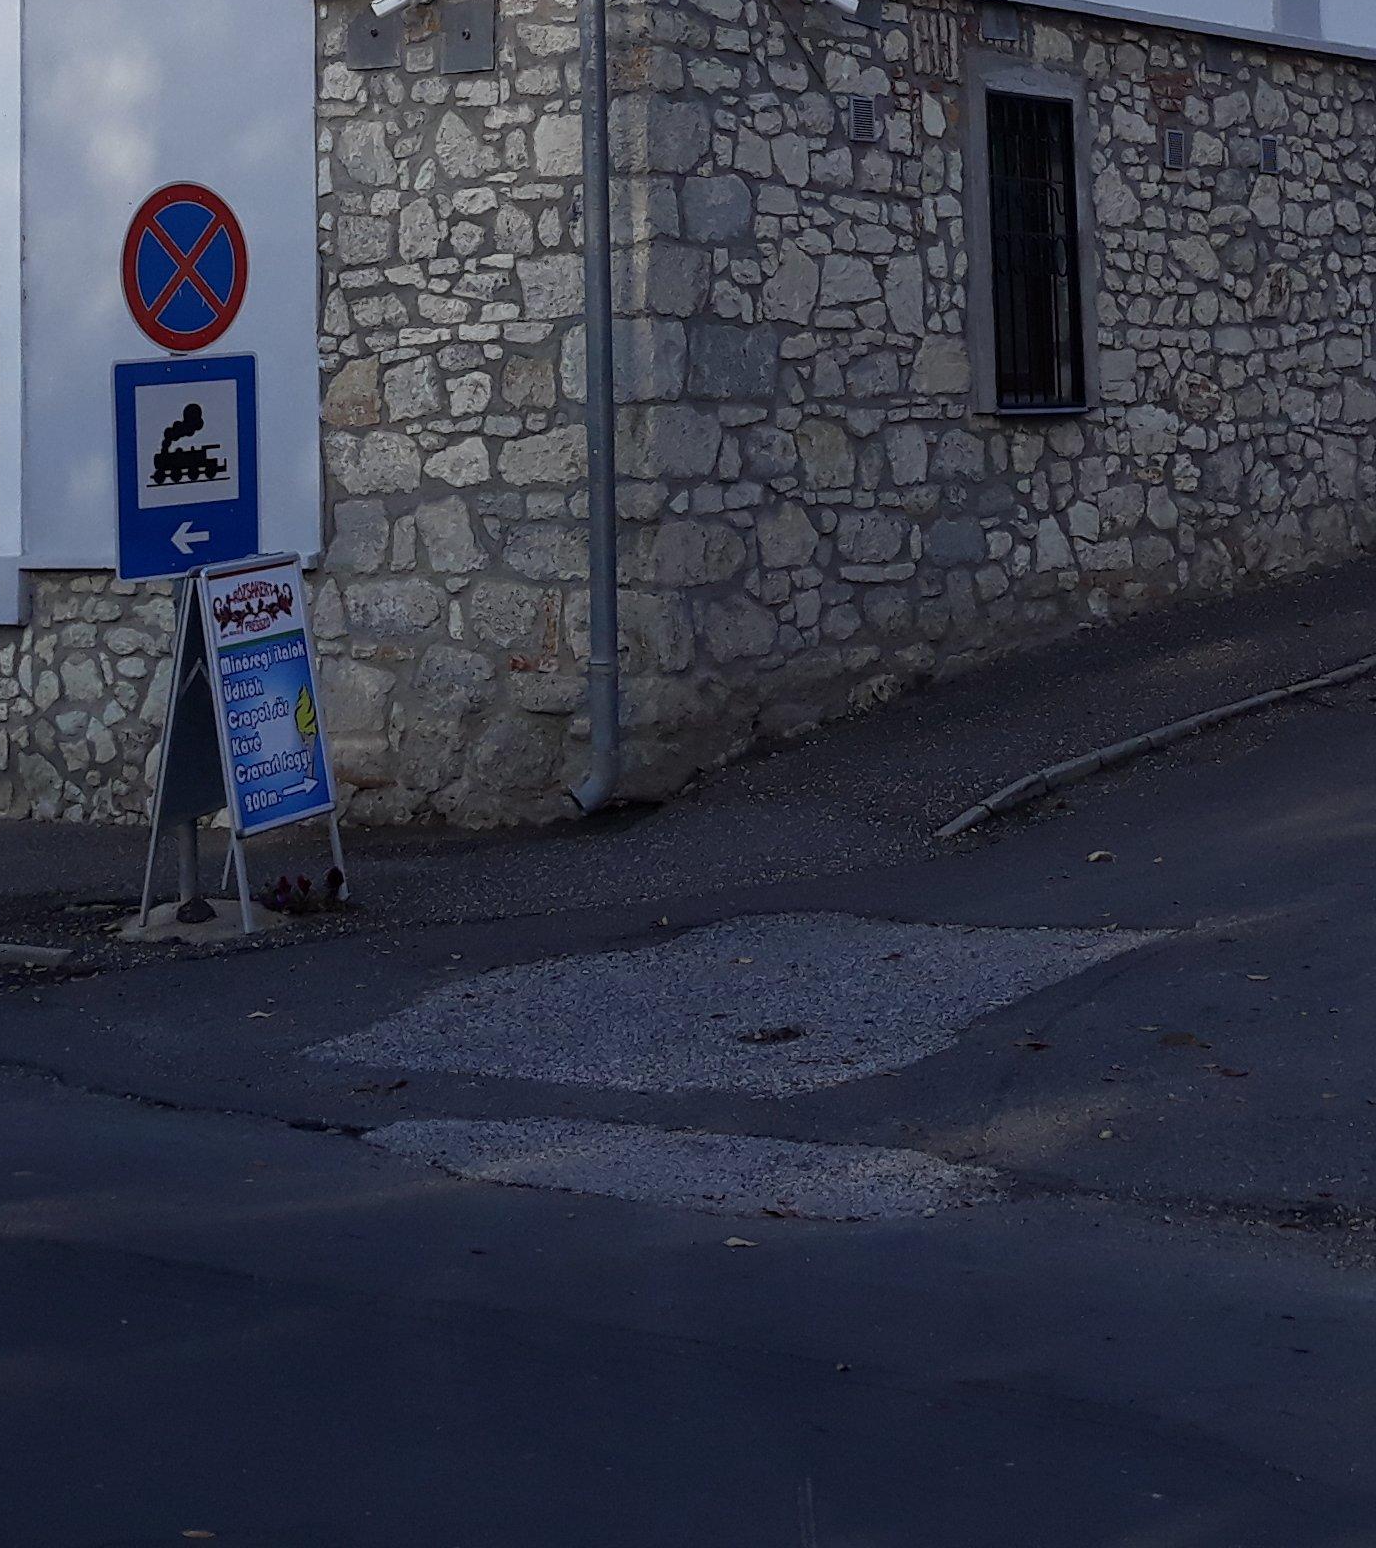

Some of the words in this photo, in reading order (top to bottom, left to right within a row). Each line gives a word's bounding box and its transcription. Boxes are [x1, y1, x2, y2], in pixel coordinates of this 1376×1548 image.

[274, 640, 306, 662] italok
[231, 732, 262, 756] Kávé
[235, 754, 281, 784] Csavart
[282, 750, 310, 772] fagyi
